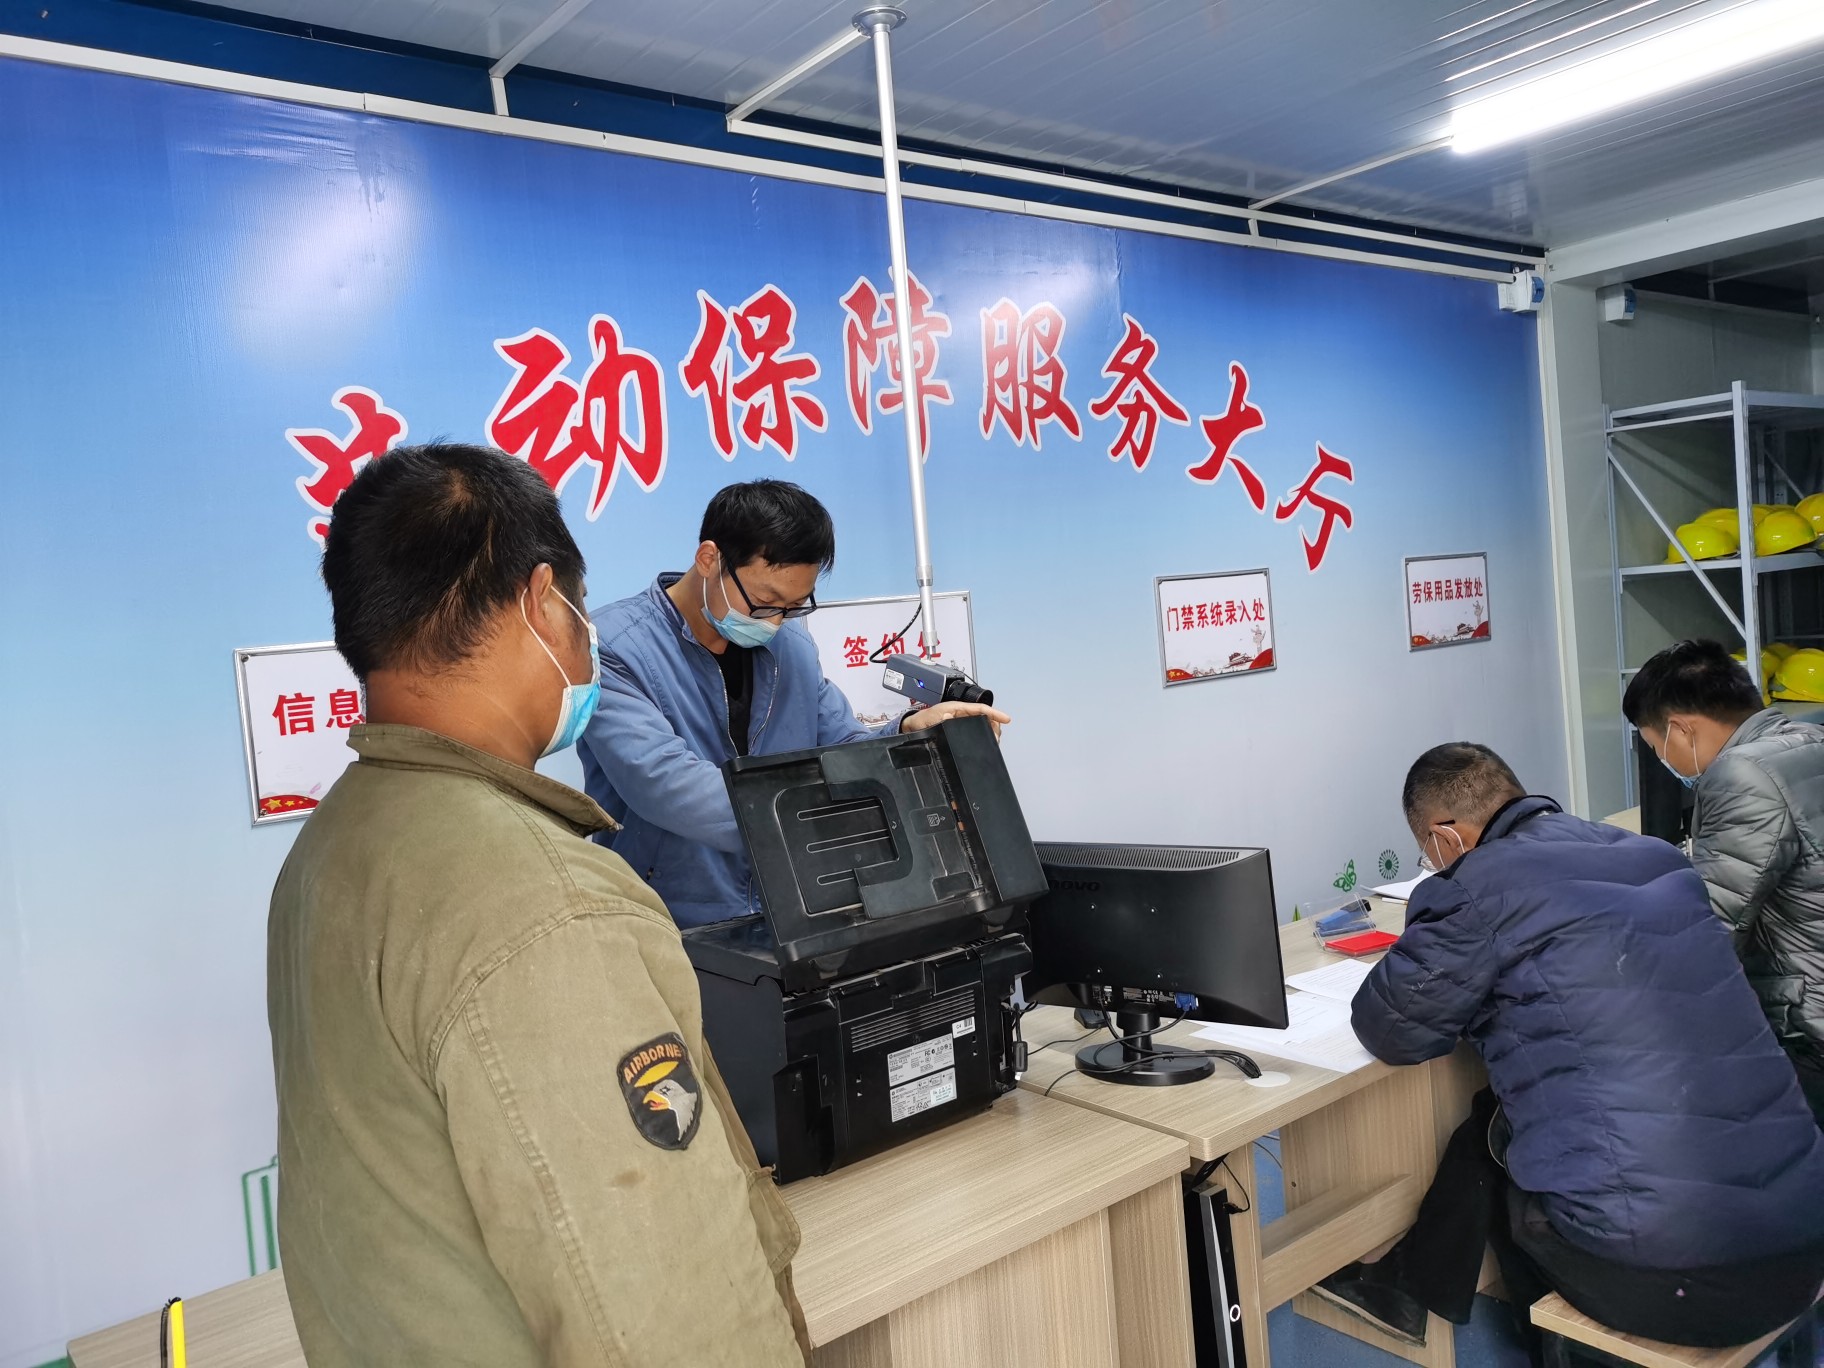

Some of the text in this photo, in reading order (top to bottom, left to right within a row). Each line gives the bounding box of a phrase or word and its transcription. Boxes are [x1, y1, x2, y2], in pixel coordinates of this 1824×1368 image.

[1412, 576, 1483, 604] 劳保用品发放处
[1166, 597, 1266, 632] 门禁系统录入处
[623, 1042, 682, 1084] AIRBORNE
